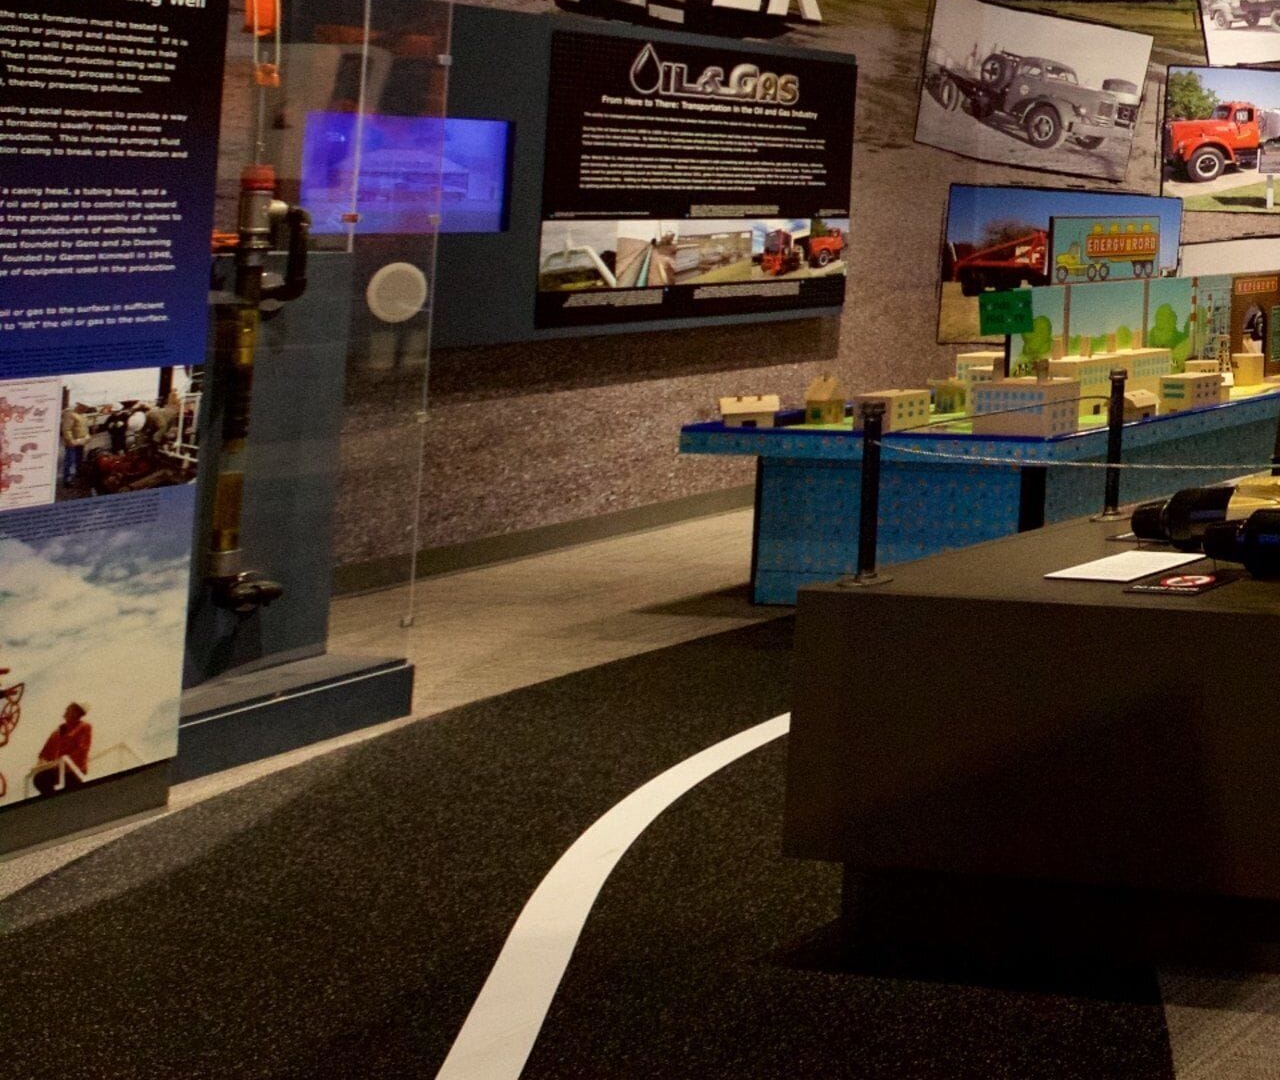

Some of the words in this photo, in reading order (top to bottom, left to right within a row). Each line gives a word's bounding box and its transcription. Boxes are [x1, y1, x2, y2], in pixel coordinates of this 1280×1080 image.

[42, 14, 88, 24] formation
[602, 94, 622, 104] From
[624, 96, 642, 106] Here
[644, 97, 653, 107] to
[681, 100, 731, 113] Transportation
[740, 105, 752, 115] the
[754, 106, 763, 116] Oil
[764, 107, 776, 117] and
[778, 108, 789, 118] Gas
[791, 109, 817, 120] Industry
[12, 188, 42, 196] casing
[83, 188, 112, 196] tubing
[42, 202, 59, 210] gas
[20, 240, 59, 248] founded
[61, 241, 73, 249] by
[1087, 238, 1125, 252] ENERGY
